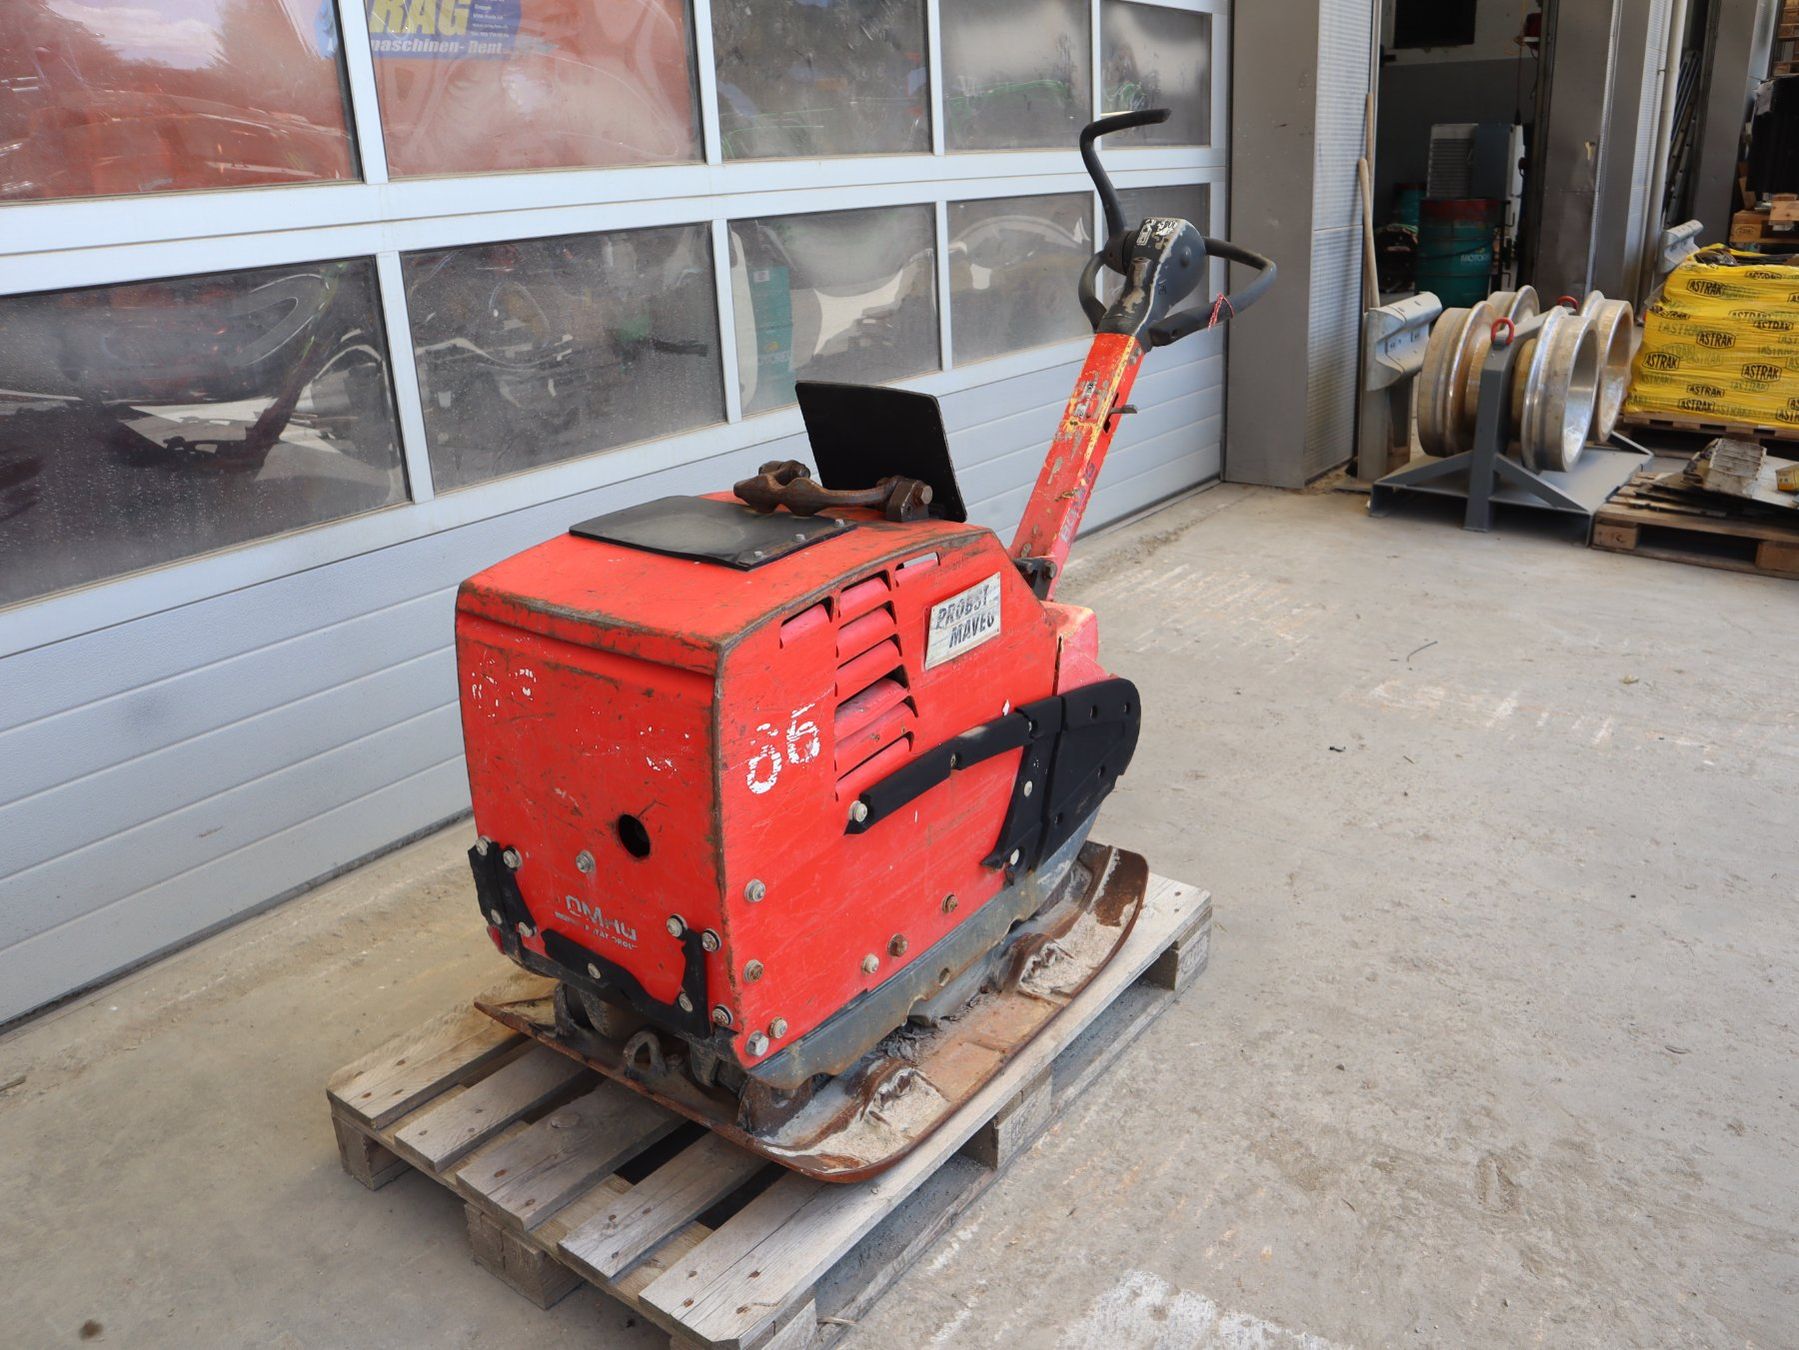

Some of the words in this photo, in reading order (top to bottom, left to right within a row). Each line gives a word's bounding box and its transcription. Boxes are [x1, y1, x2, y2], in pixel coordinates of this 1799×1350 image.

[1689, 280, 1723, 295] ASTRAK
[1699, 332, 1732, 347] ASTRAK
[1645, 353, 1677, 369] ASTRAK
[1744, 365, 1779, 380] ASTRAK
[1690, 385, 1722, 397] ASTRAK
[1681, 400, 1712, 412] ASTRAK
